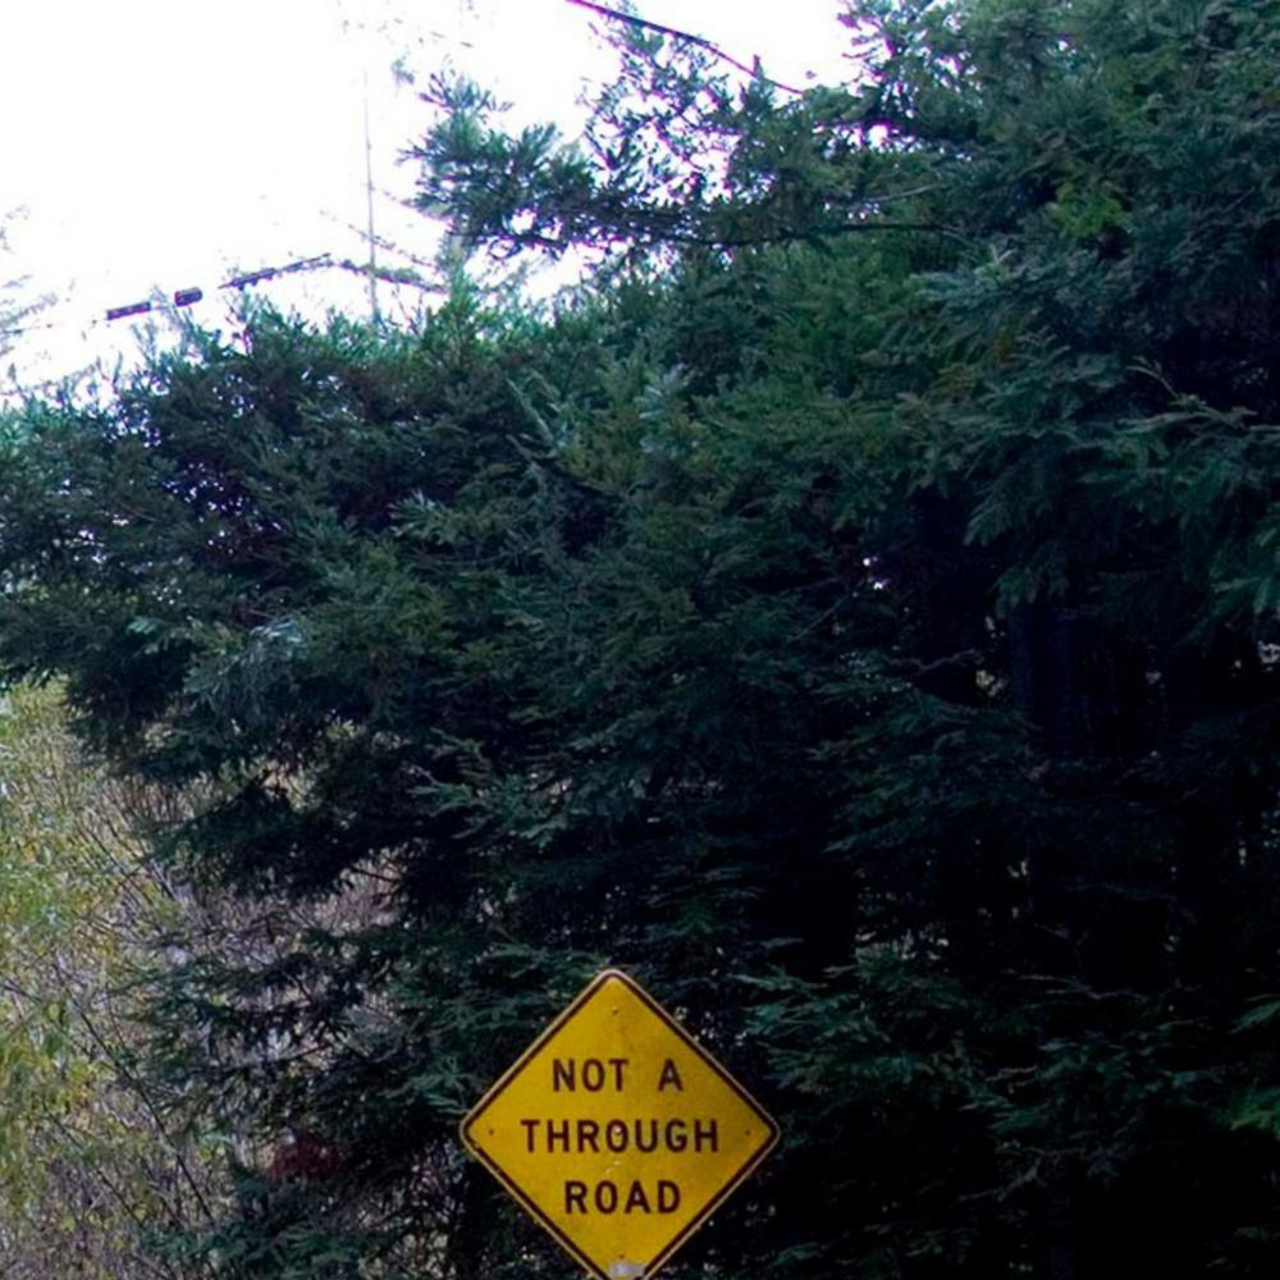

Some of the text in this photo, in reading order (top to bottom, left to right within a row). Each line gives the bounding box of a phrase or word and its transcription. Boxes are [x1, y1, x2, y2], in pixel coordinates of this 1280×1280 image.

[552, 1059, 684, 1092] NOT A
[520, 1119, 719, 1153] THROUGH
[564, 1181, 681, 1215] ROAD
